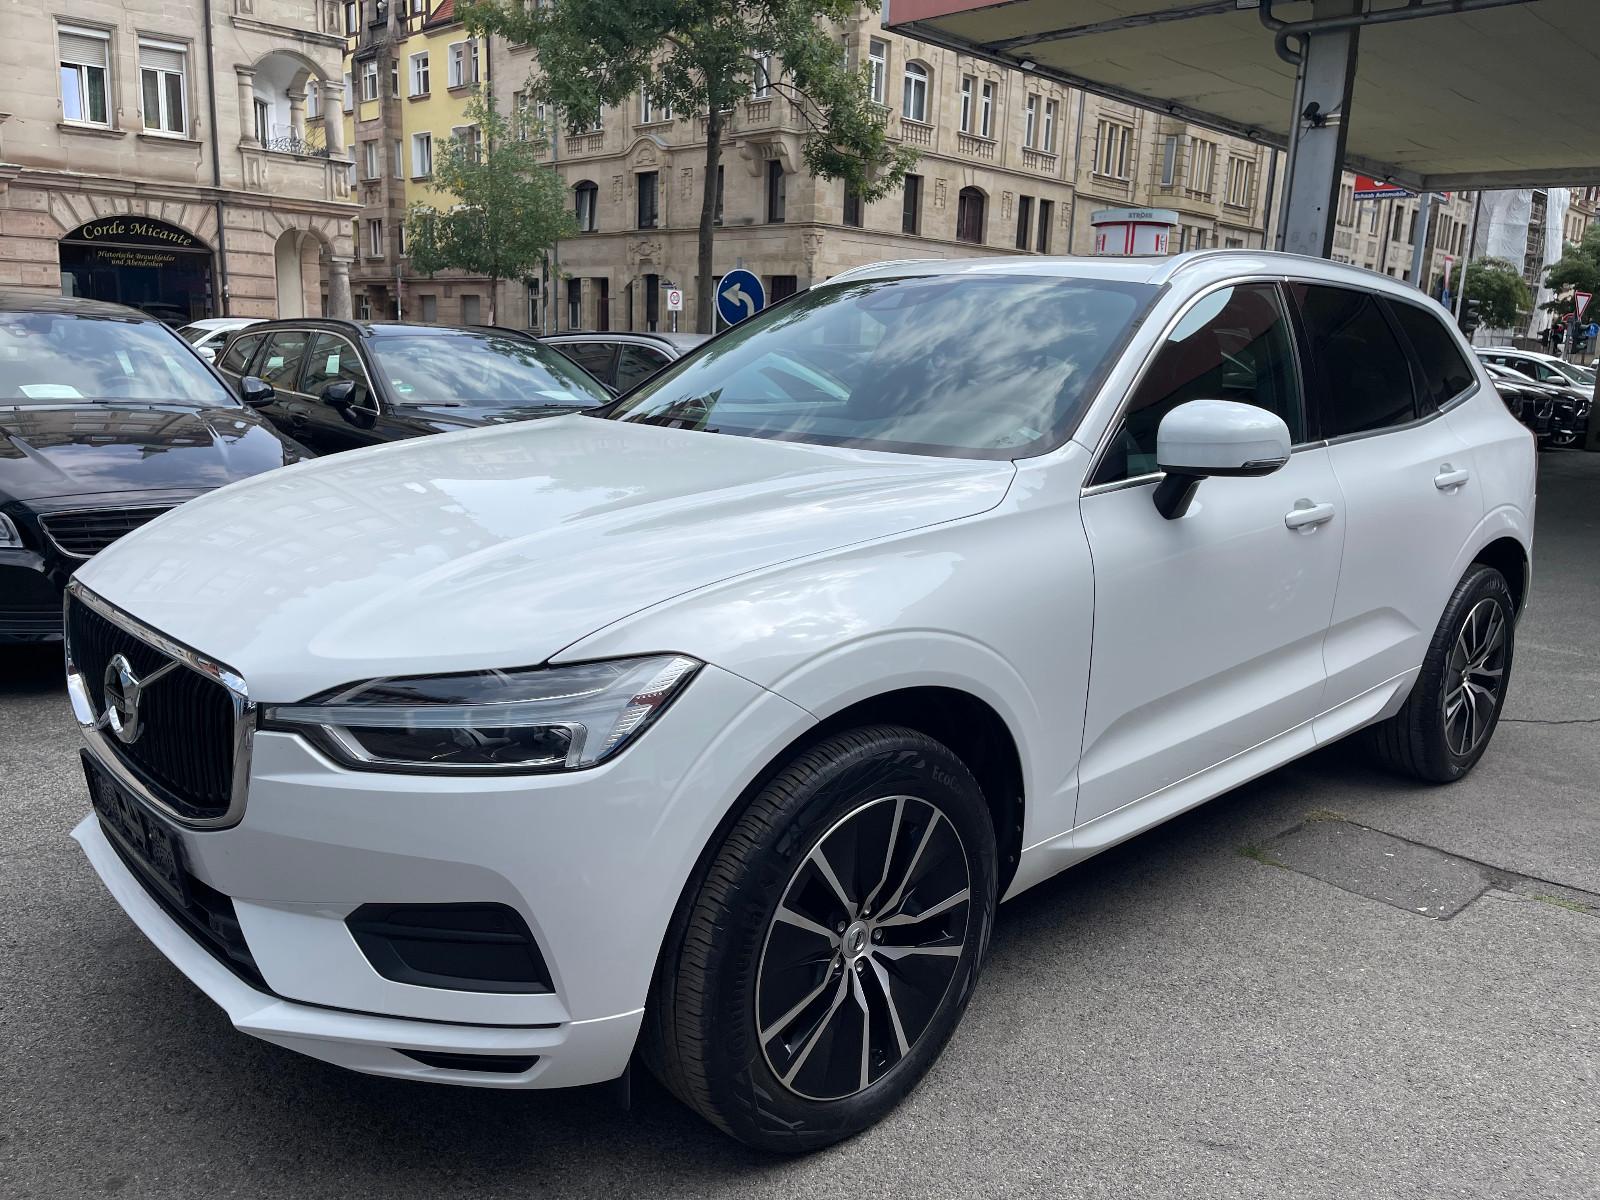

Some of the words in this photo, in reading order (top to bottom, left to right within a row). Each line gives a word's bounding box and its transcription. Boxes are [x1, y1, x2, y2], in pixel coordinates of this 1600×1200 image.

[83, 220, 125, 239] Corde
[130, 222, 192, 246] Micante
[636, 692, 663, 700] VOLVO
